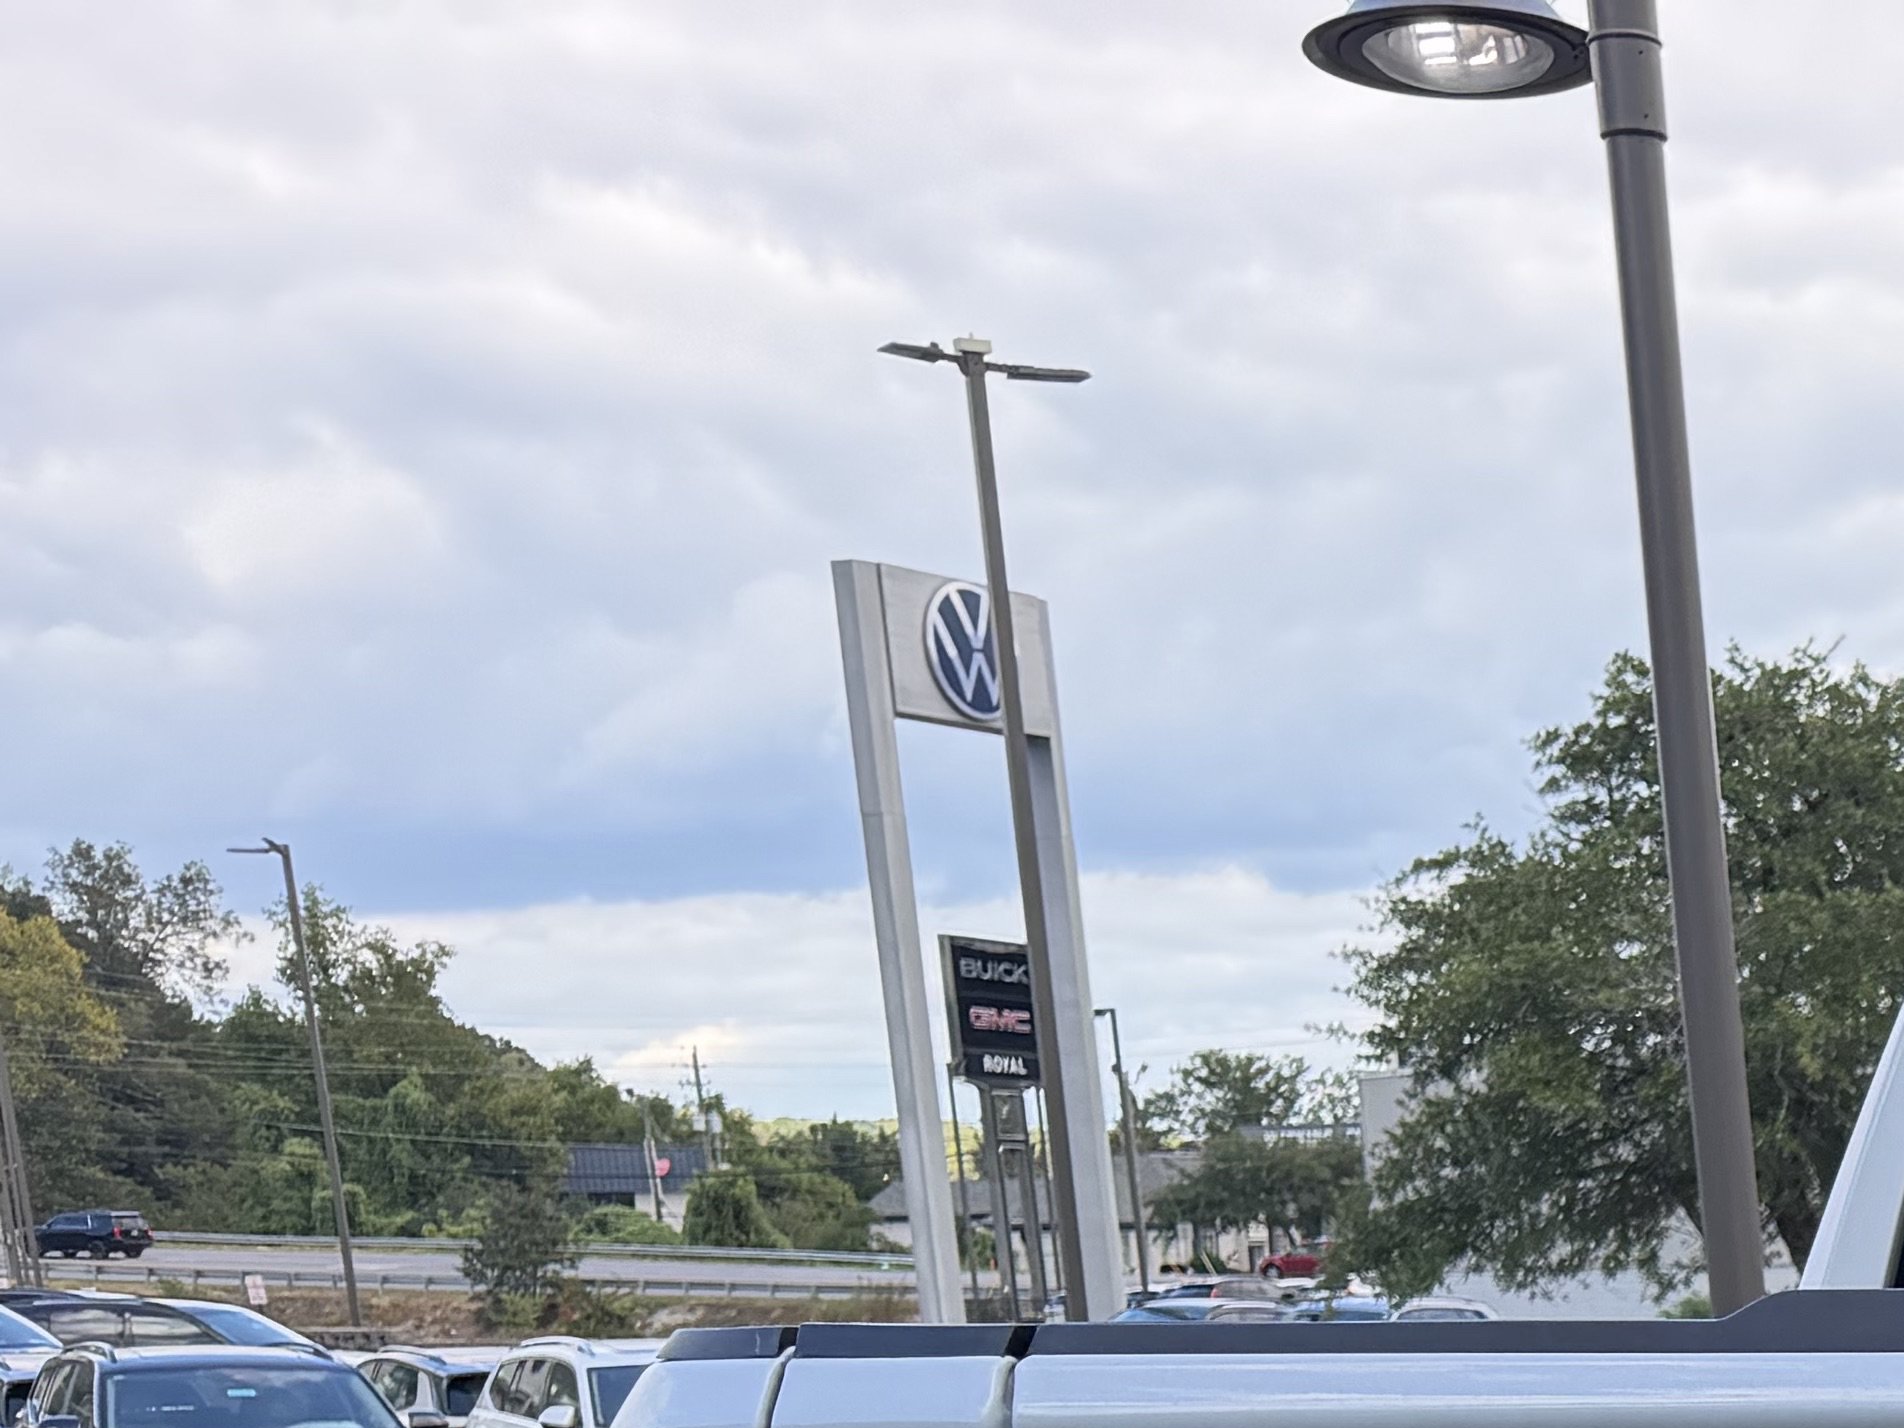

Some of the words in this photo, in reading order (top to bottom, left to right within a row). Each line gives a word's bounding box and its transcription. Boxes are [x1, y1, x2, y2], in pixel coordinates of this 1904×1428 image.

[959, 957, 1029, 984] BUICK
[969, 1005, 1031, 1034] GMC
[983, 1054, 1028, 1076] ROYAL
